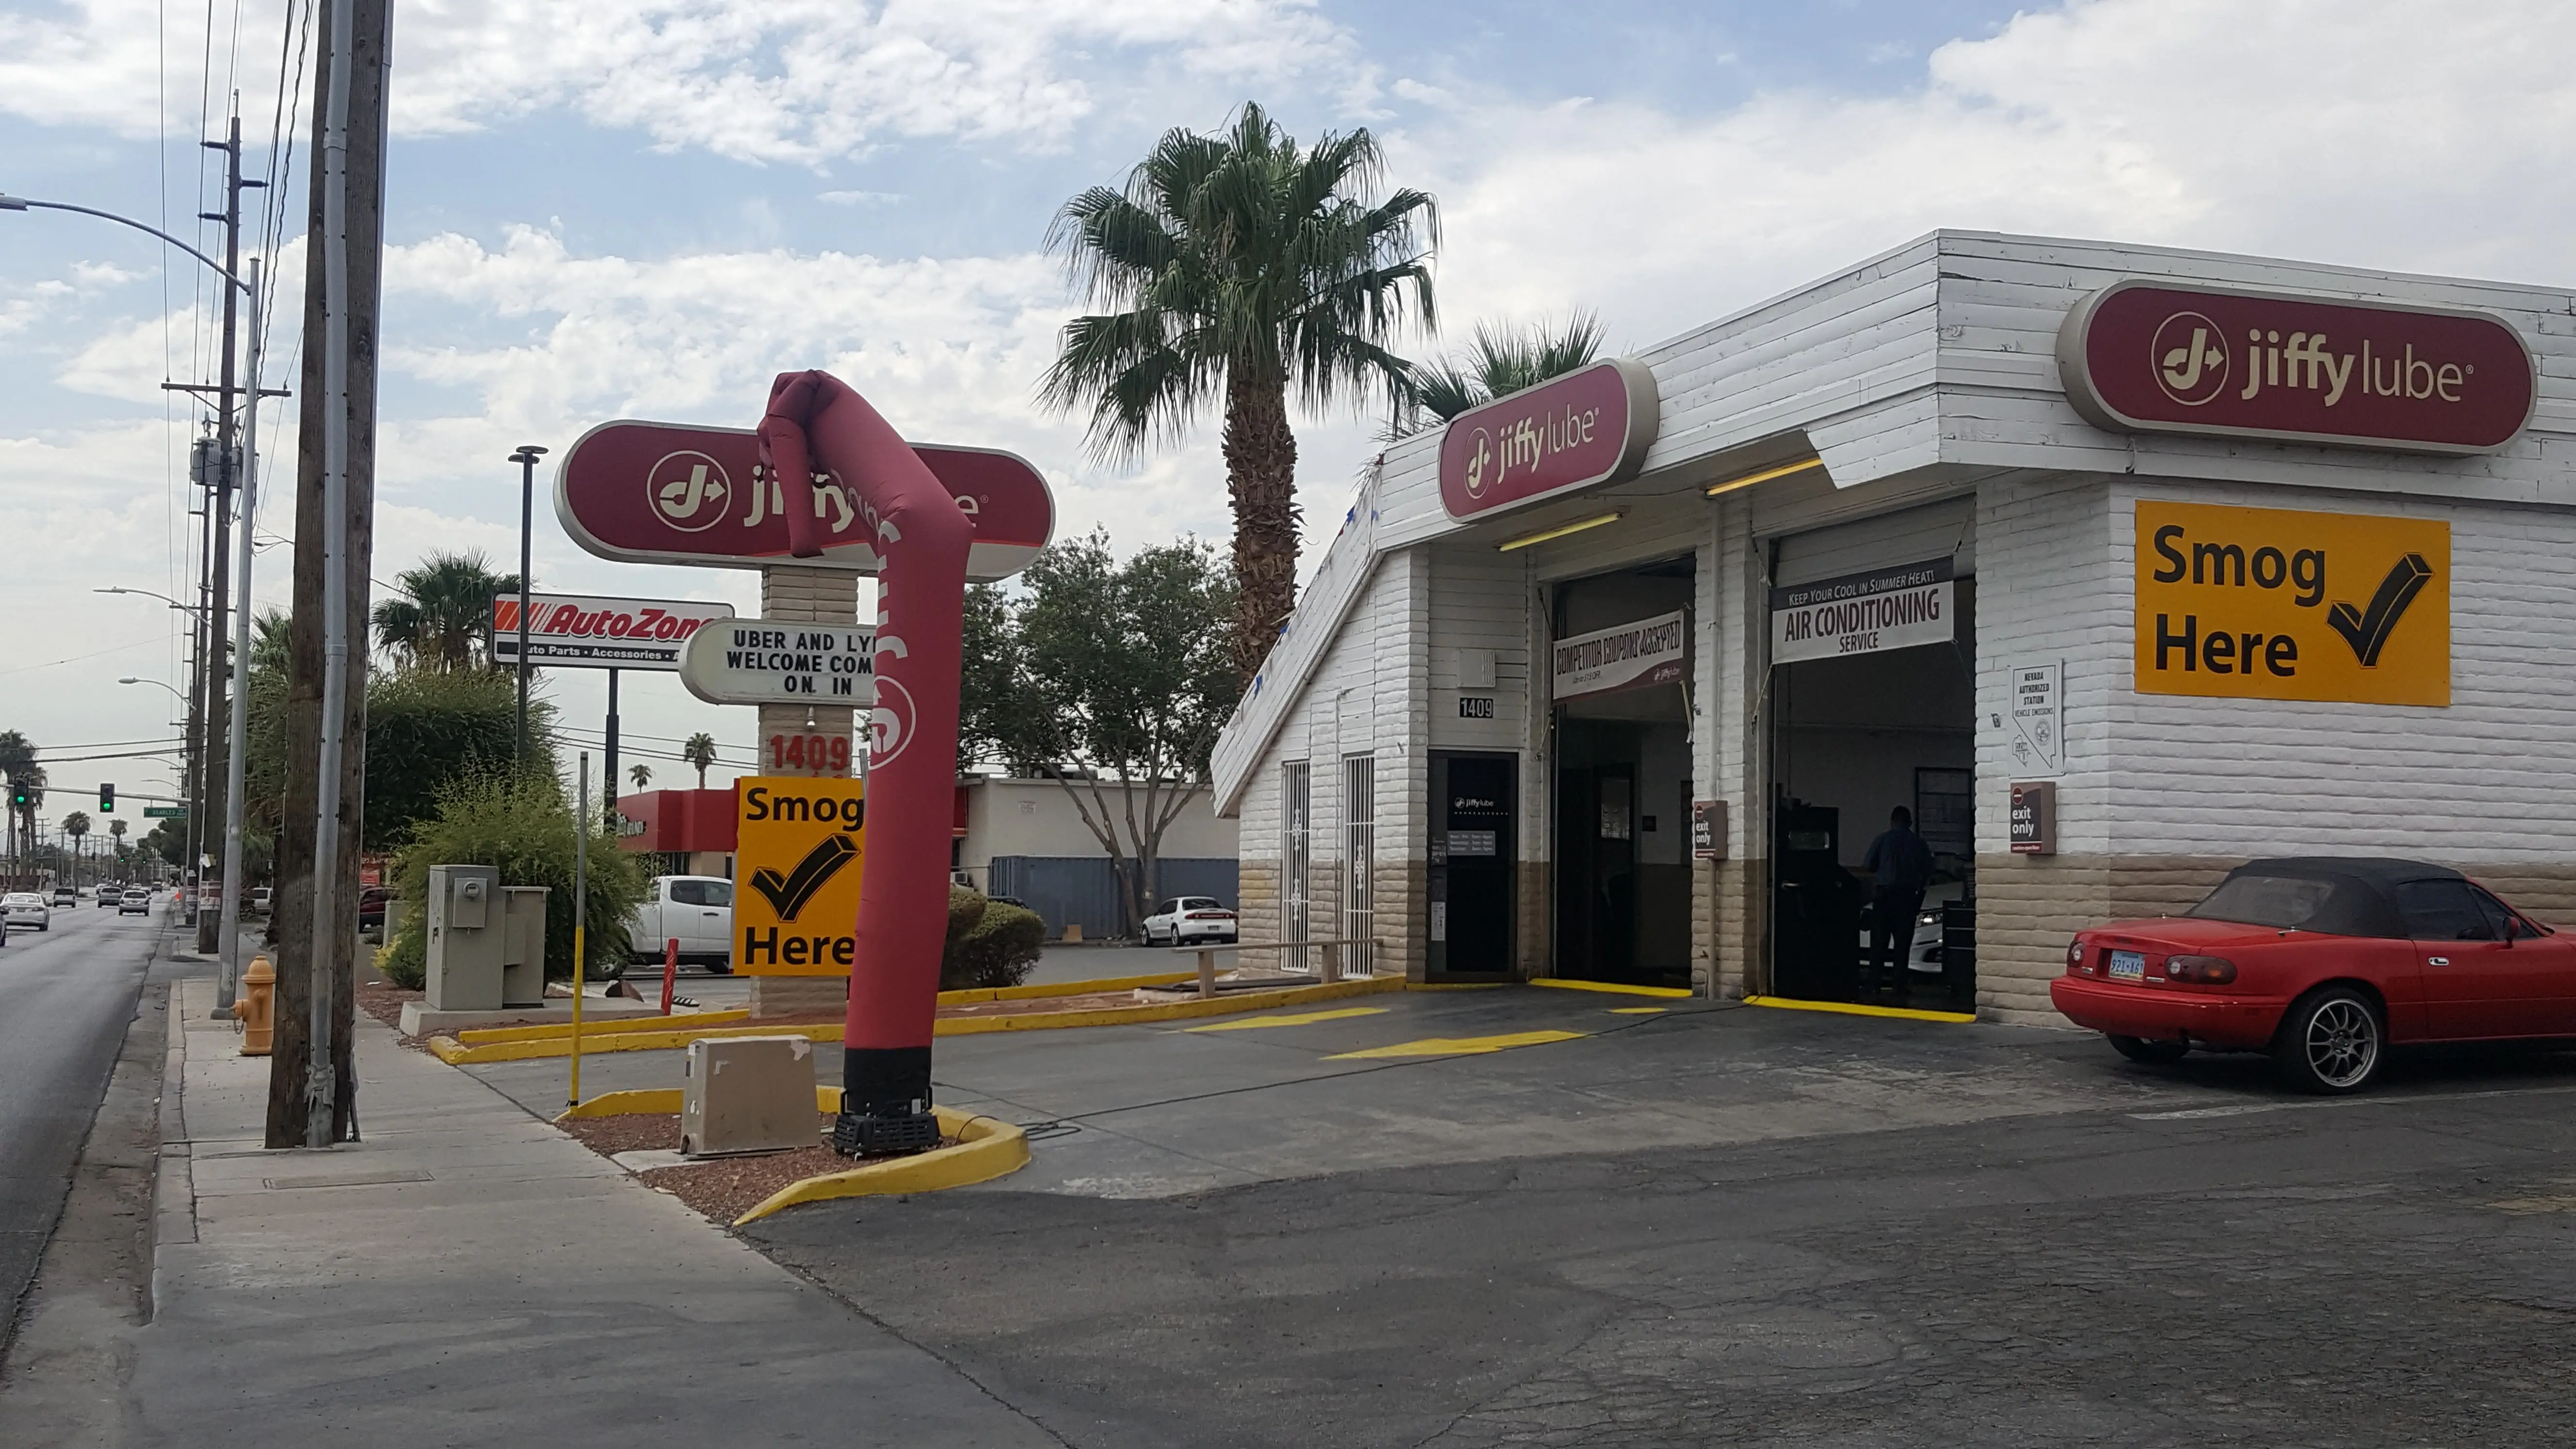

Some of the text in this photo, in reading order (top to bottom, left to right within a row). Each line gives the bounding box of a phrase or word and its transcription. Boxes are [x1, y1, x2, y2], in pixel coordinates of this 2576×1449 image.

[2241, 329, 2355, 406] jiffy
[1497, 416, 1544, 484] jiffy
[2153, 524, 2326, 607] Smog
[1789, 570, 1934, 606] KEEP YOUR COOL IN SUMMER HEAT!
[1785, 588, 1940, 642] AIR CONDITIONING
[518, 645, 661, 660] uto Parts Accessories
[734, 630, 876, 653] UBER AND LY
[1557, 639, 1602, 675] COMPETITOR
[1640, 620, 1681, 657] ACCEPTED
[1839, 632, 1879, 653] SERVICE
[2155, 613, 2298, 677] Here
[727, 651, 872, 674] WELCOME COM
[833, 677, 852, 695] IN
[1461, 699, 1492, 717] 1409
[770, 735, 848, 770] 1409
[746, 787, 864, 832] Smog
[2012, 805, 2031, 819] exit
[1696, 821, 1708, 831] exit
[1696, 832, 1711, 845] only
[2012, 820, 2034, 837] only
[745, 927, 855, 965] Here
